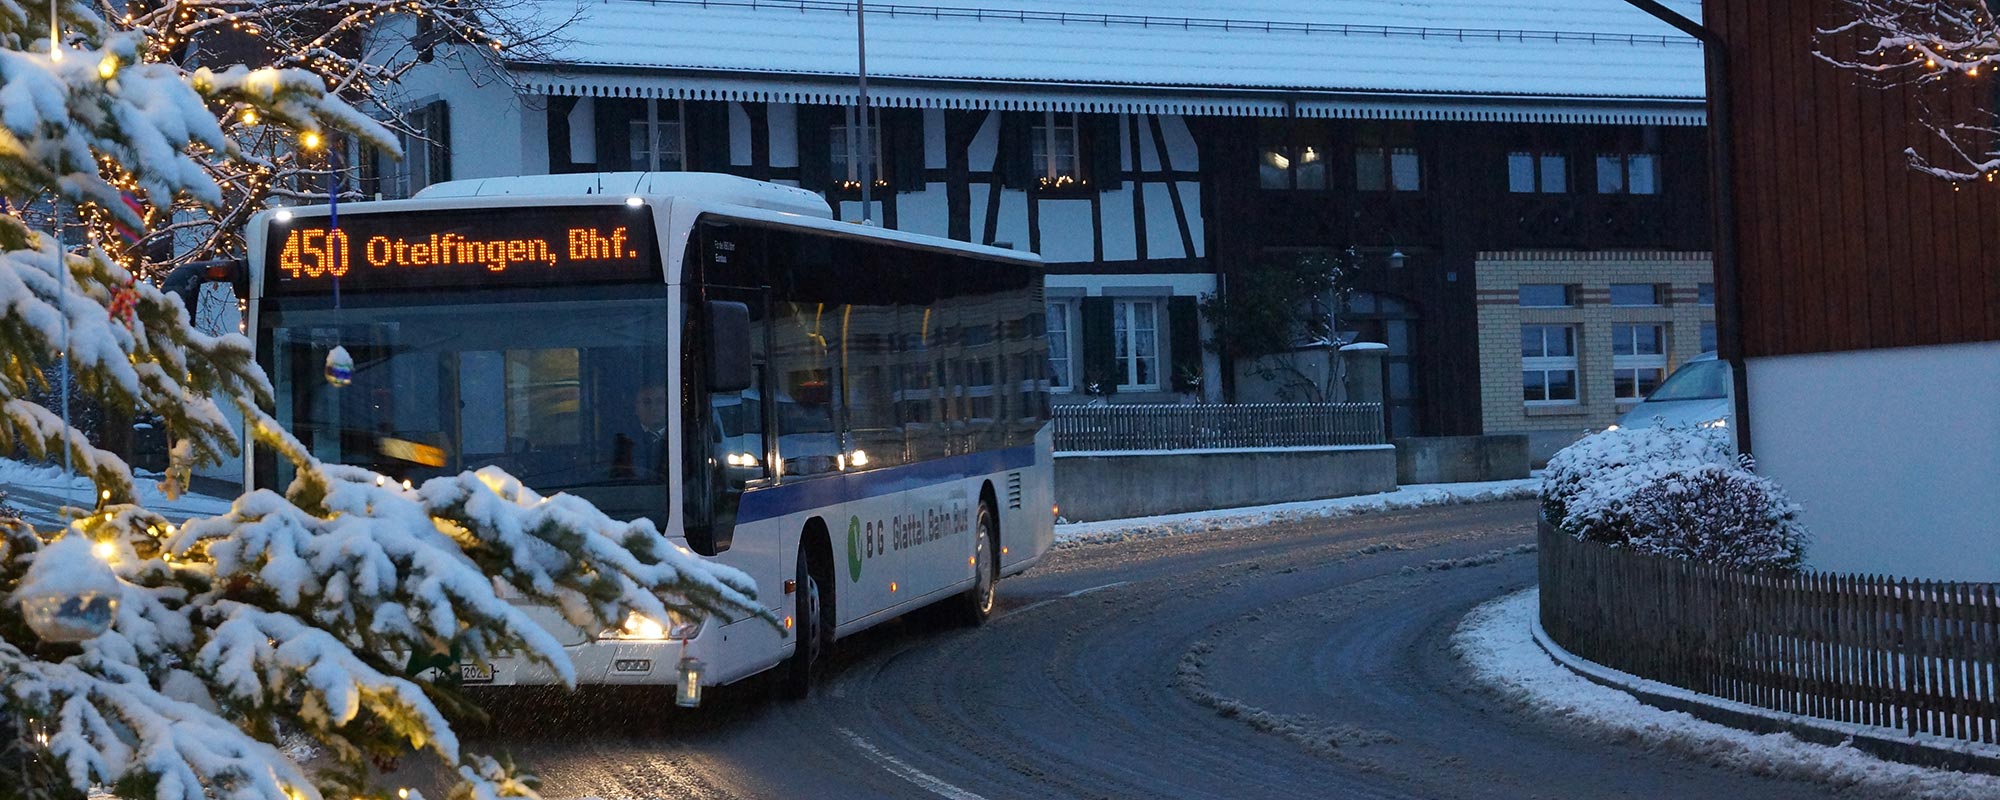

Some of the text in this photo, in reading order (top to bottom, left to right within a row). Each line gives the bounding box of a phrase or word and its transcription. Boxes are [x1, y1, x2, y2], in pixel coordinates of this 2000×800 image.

[280, 226, 637, 278] 450 Otelfingen, Bhf.
